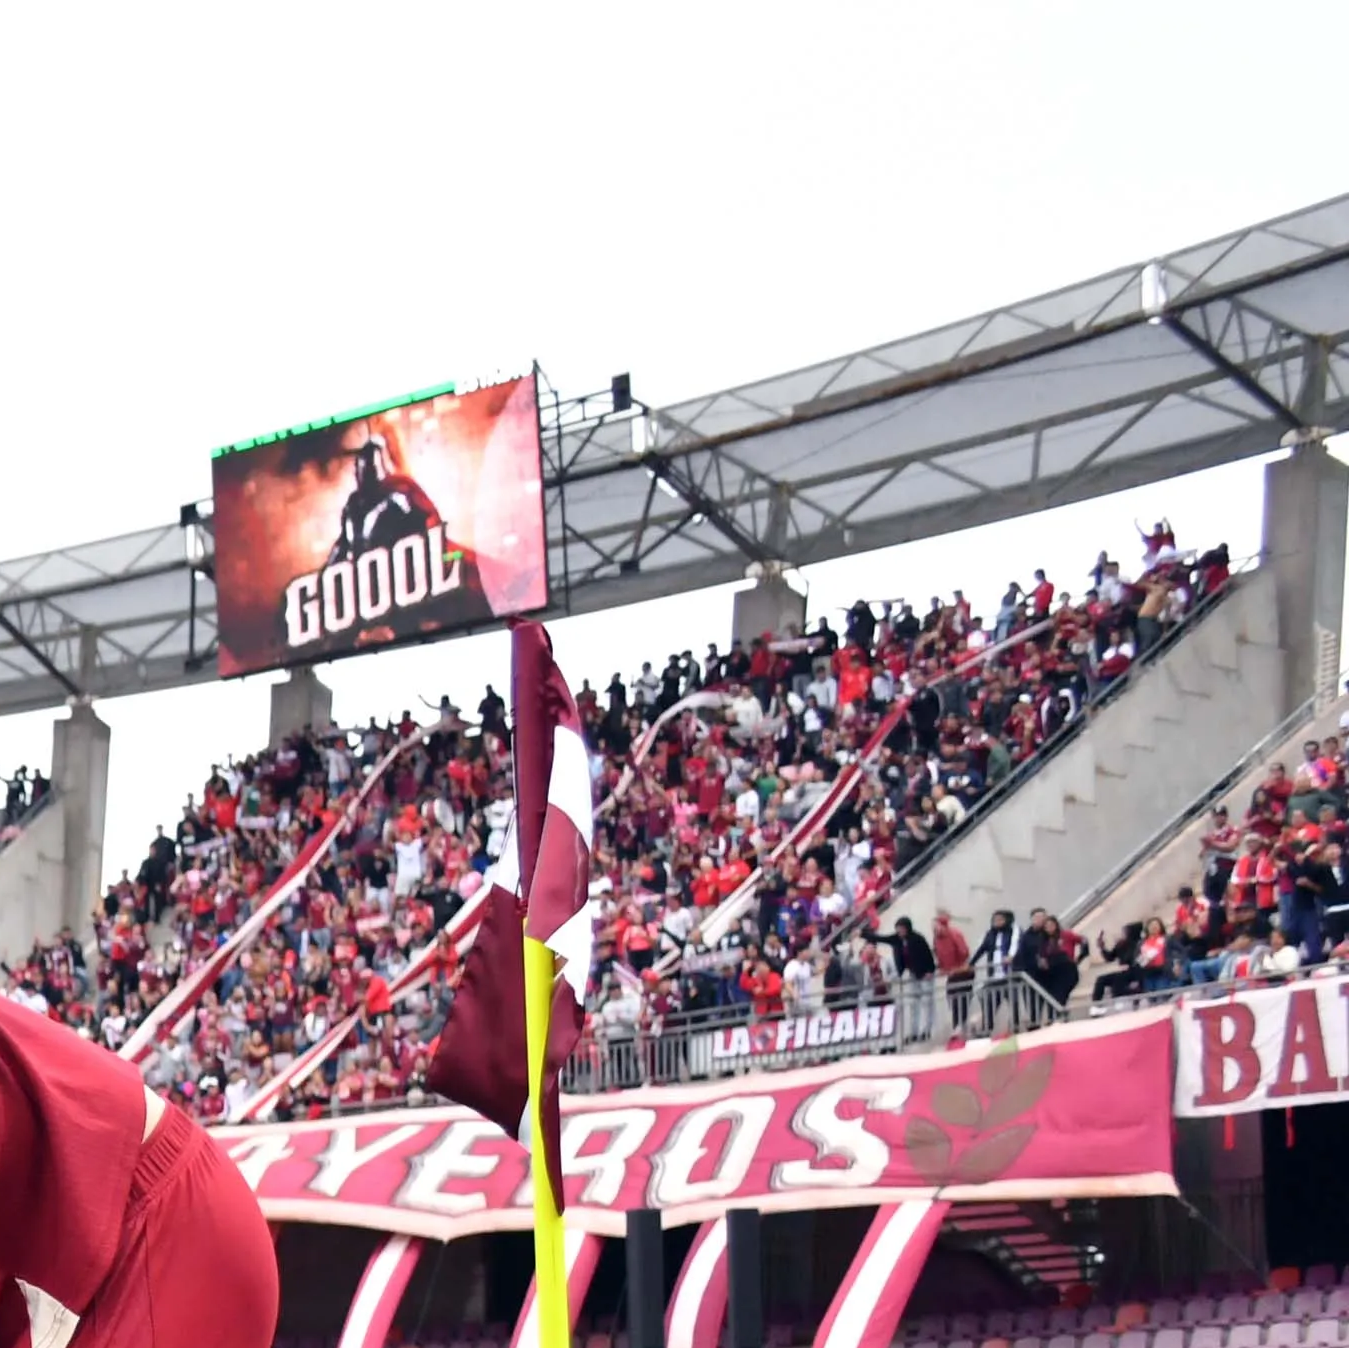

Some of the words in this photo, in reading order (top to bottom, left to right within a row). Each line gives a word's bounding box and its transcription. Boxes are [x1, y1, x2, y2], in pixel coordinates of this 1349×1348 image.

[285, 522, 462, 648] GOOOL
[713, 1027, 750, 1058] LA
[776, 1004, 897, 1051] FIGARI
[1193, 983, 1349, 1108] BA
